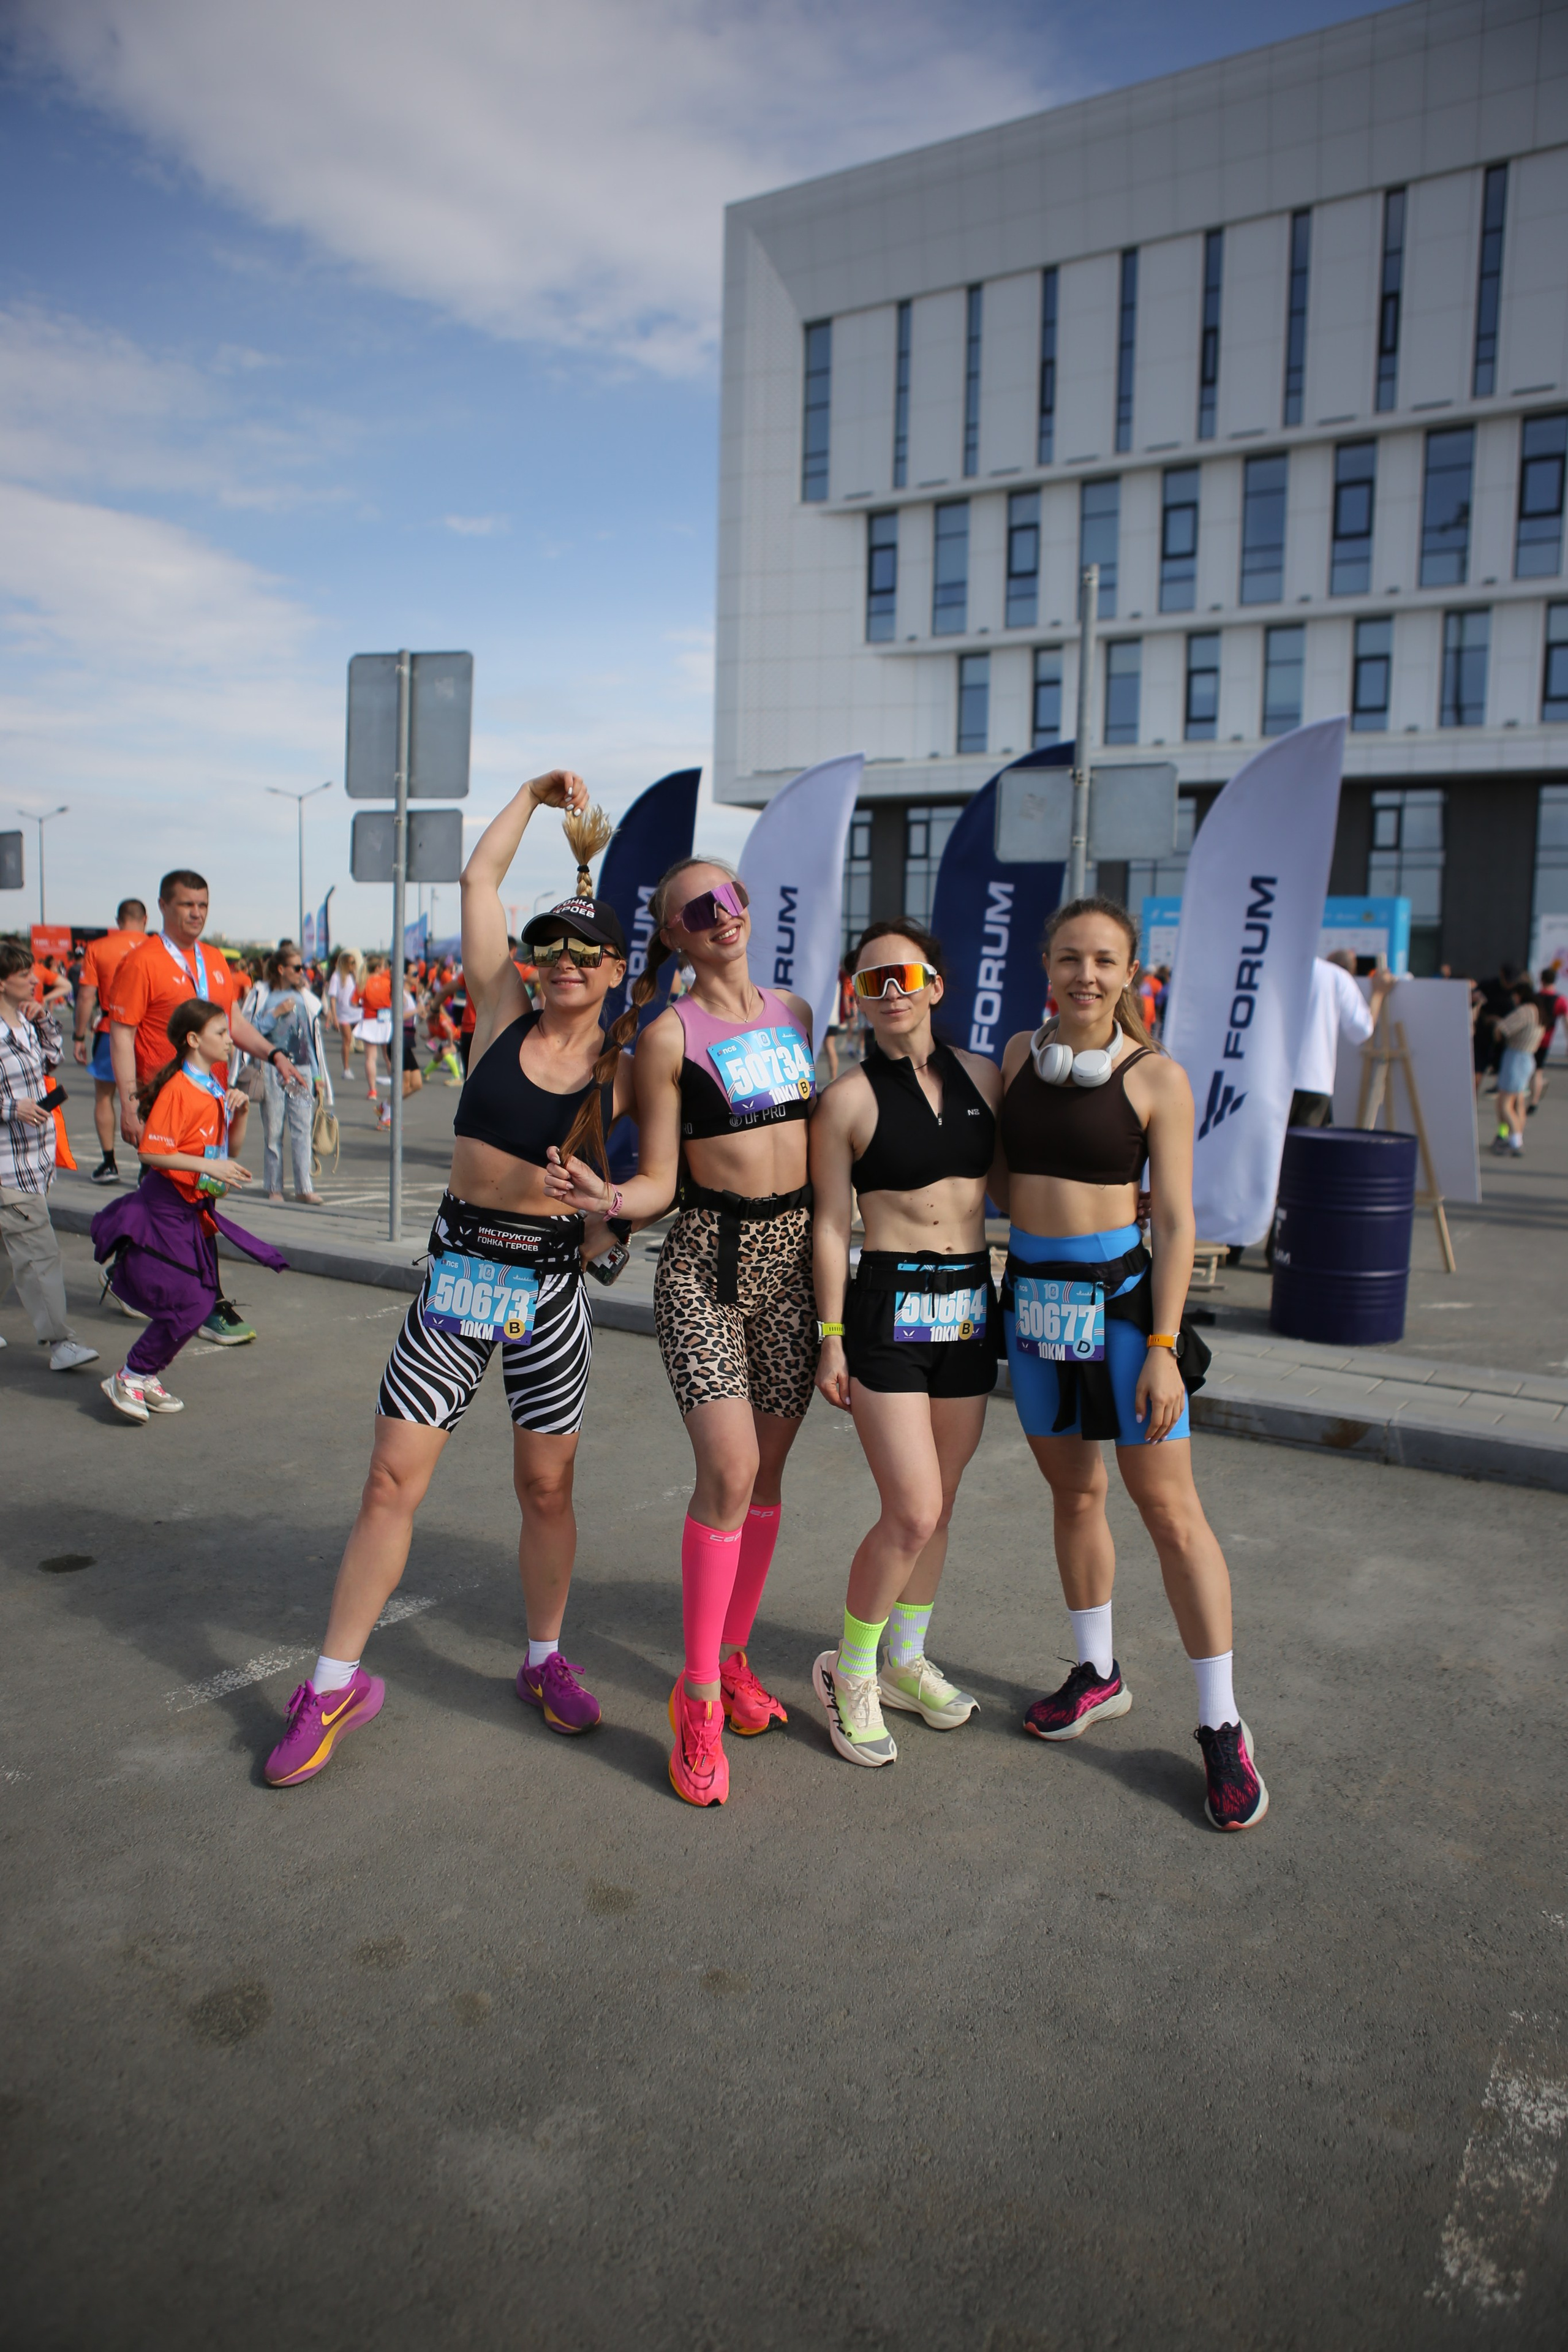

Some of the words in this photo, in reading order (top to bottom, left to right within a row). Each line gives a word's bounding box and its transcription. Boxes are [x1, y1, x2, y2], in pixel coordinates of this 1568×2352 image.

[774, 886, 798, 992] RUM
[969, 881, 1014, 1054] FORUM
[1223, 876, 1278, 1060] FORUM
[723, 1046, 737, 1055] ПСБ
[725, 1044, 810, 1095] 50734
[762, 1105, 786, 1121] PRO
[682, 1122, 693, 1134] RO
[478, 1226, 542, 1242] ИНСТРУКТОР
[478, 1235, 503, 1248] ГОНКА
[505, 1242, 539, 1252] ГЕРОЕВ
[446, 1260, 459, 1268] ПСБ
[478, 1263, 496, 1281] 10
[434, 1273, 530, 1324] 50673
[1044, 1283, 1060, 1300] 10
[902, 1287, 983, 1324] 50664
[1019, 1298, 1096, 1341] 50677
[1077, 1340, 1091, 1354] D
